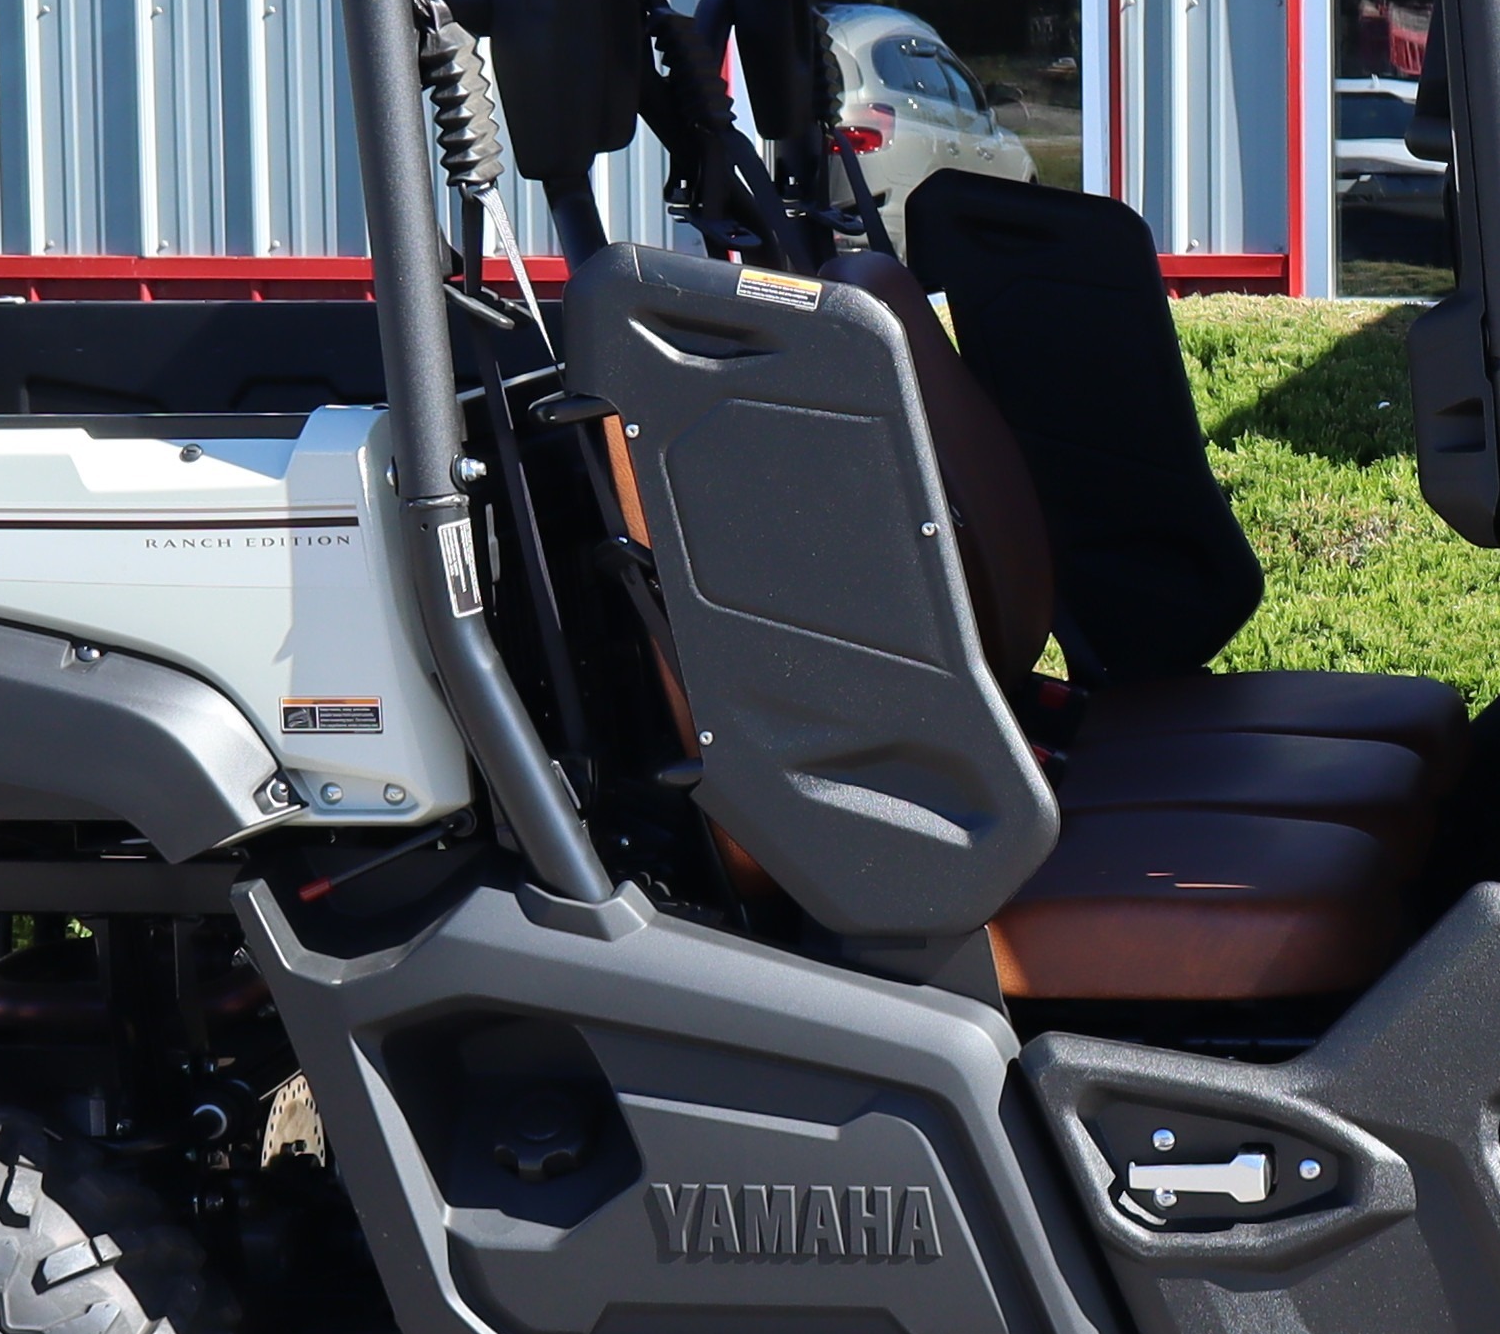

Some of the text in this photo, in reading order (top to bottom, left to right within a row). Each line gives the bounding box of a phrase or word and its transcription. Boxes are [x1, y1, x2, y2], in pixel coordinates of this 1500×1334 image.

[145, 534, 351, 549] RANCH EDITION
[649, 1181, 943, 1257] YAMAHA
